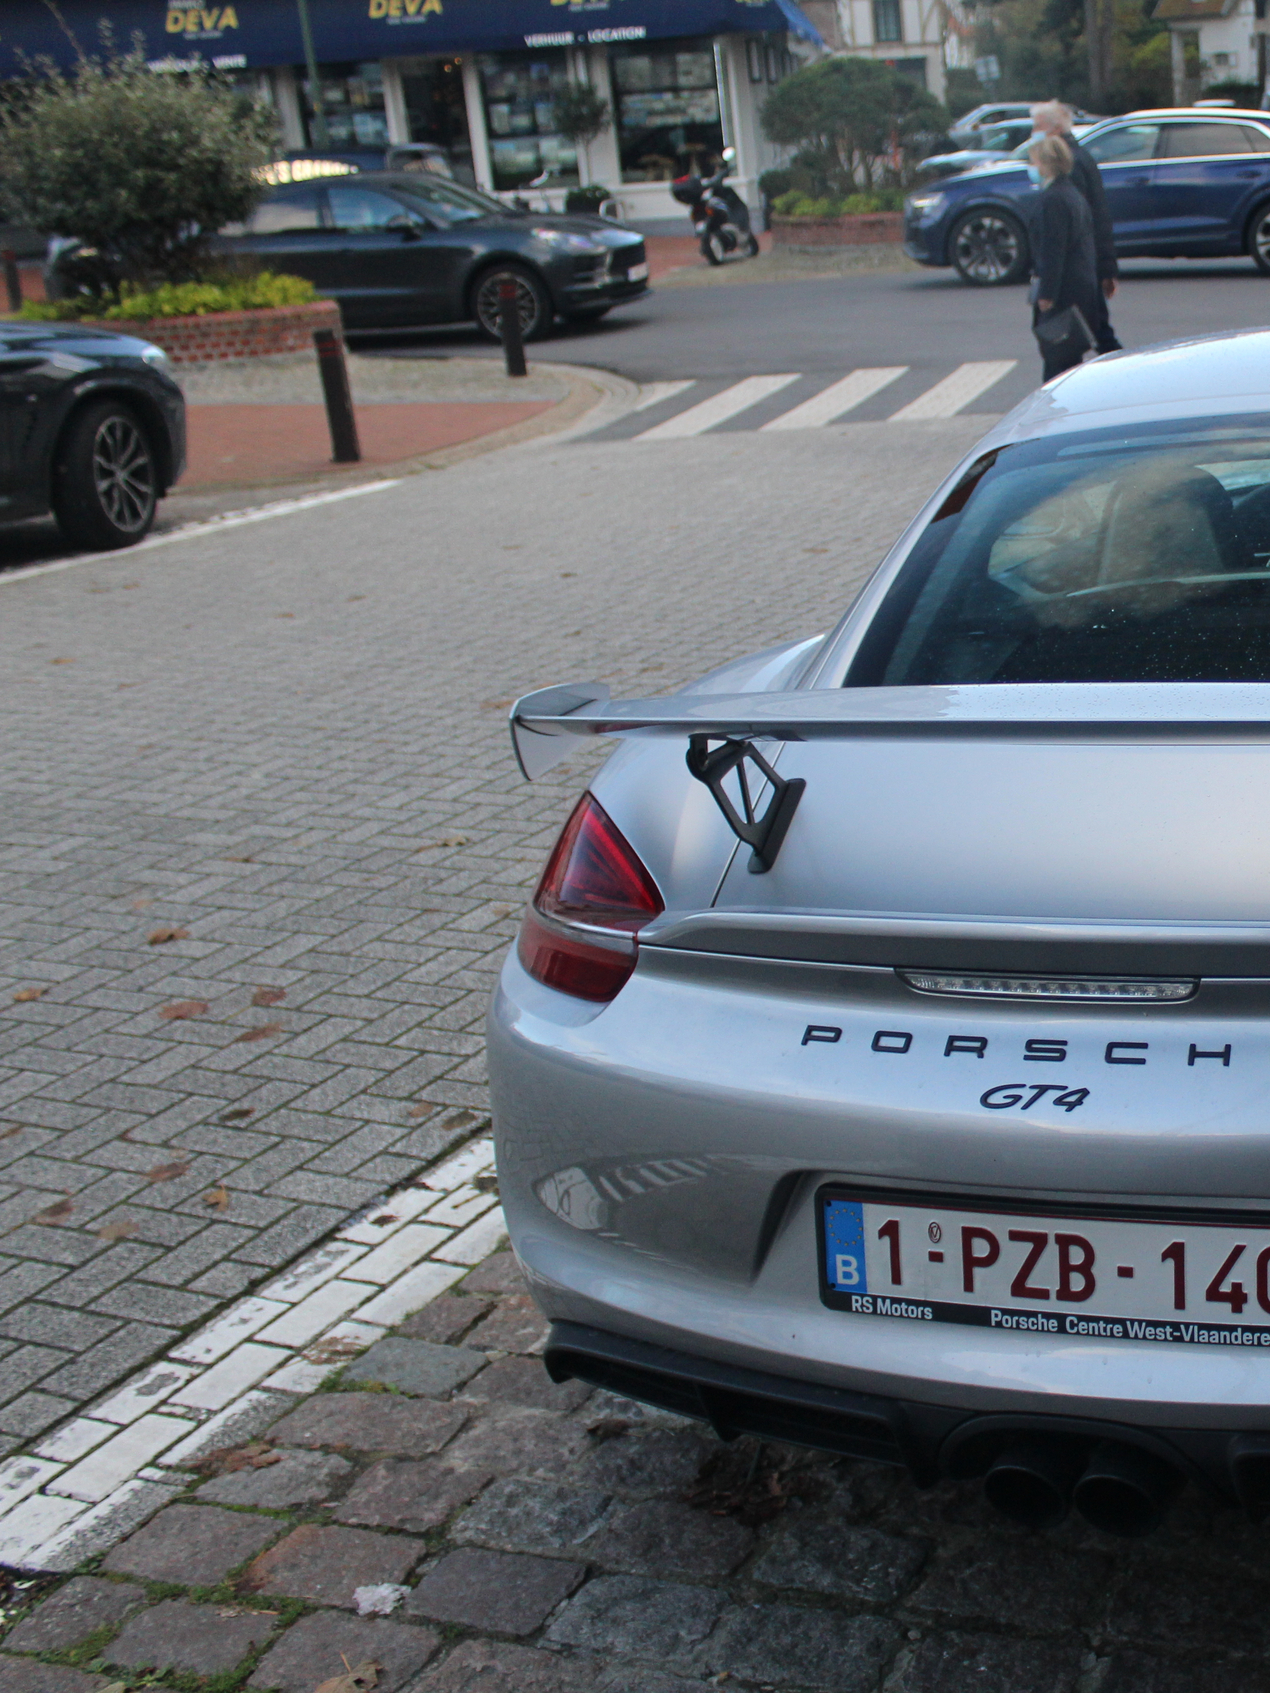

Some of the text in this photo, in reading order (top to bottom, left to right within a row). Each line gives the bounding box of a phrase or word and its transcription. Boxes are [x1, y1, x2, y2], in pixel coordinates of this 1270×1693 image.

[165, 5, 239, 34] DEVA
[369, 0, 443, 19] DEVA
[524, 31, 575, 48] VERHUUR
[587, 25, 646, 43] LOCATION
[980, 1083, 1090, 1112] GT4
[835, 1254, 859, 1286] B
[851, 1295, 933, 1320] RS Motors
[991, 1310, 1058, 1332] Porsche
[1065, 1316, 1123, 1337] Centre
